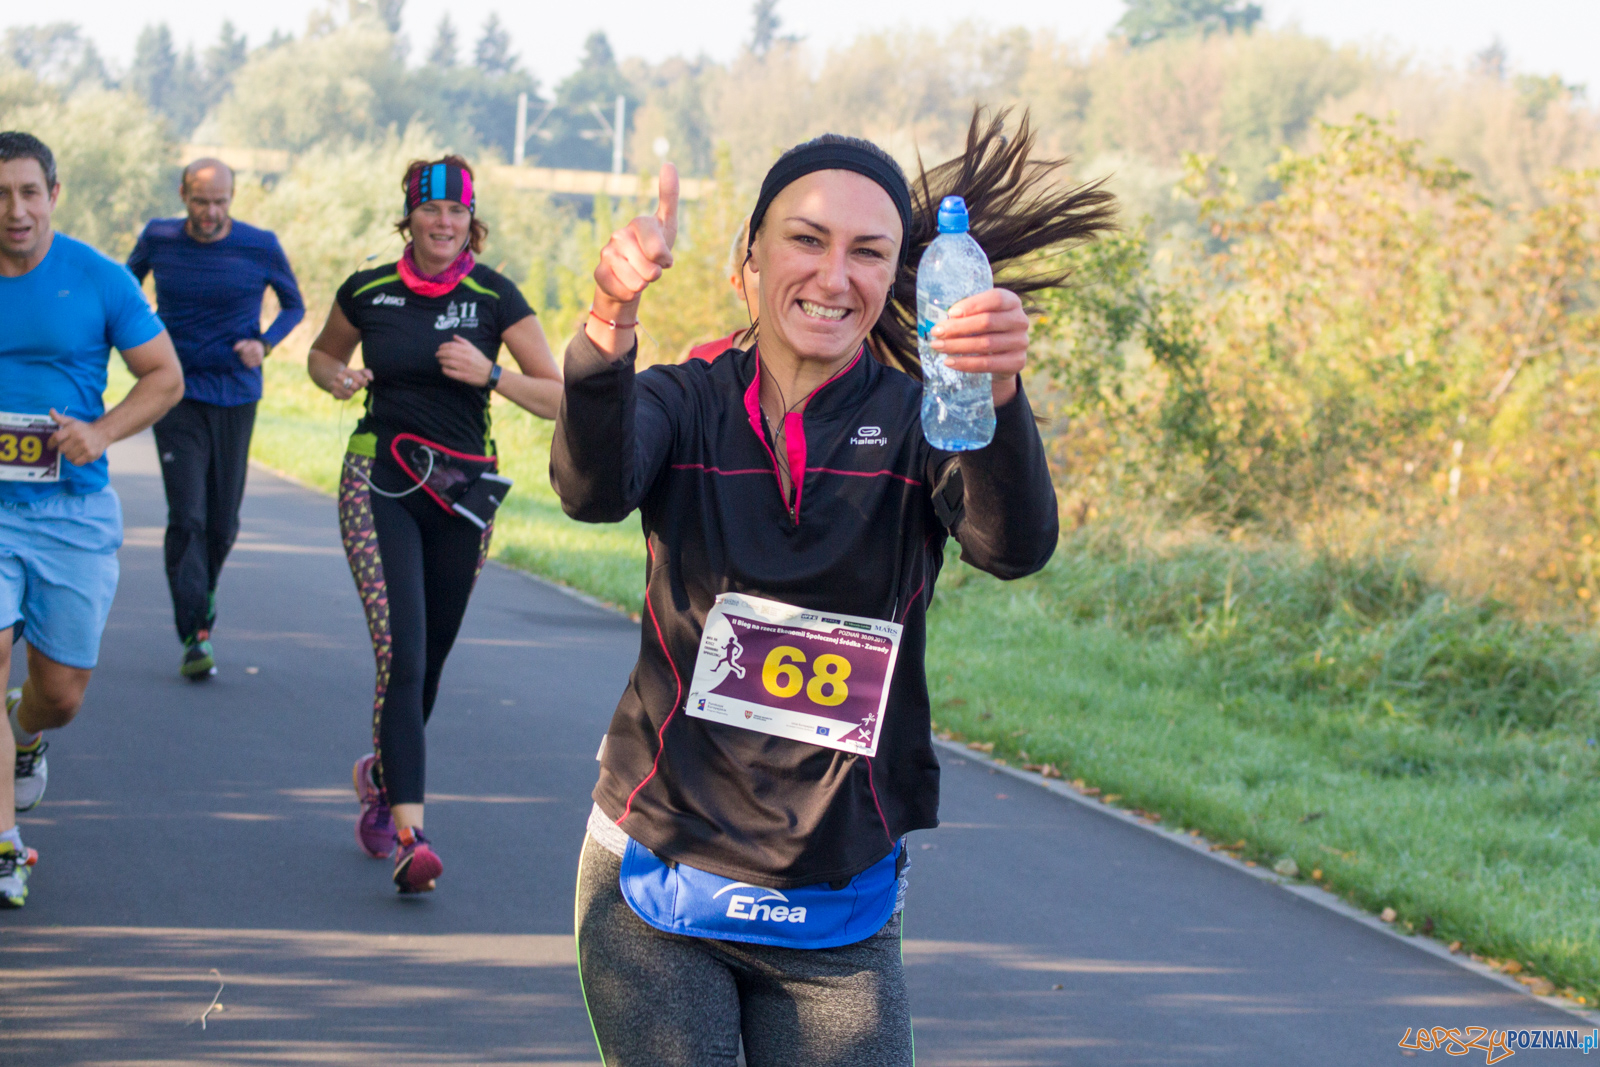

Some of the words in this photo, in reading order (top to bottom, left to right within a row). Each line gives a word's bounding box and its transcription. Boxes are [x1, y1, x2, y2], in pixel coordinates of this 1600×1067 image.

[460, 302, 477, 318] 11
[0, 434, 42, 463] 39
[850, 437, 887, 446] Kalenji
[738, 620, 751, 629] Bieg
[777, 628, 805, 637] Ekonomii
[865, 643, 889, 654] Zawady
[861, 634, 886, 643] 30.09.2017
[874, 625, 898, 635] MARS
[762, 645, 852, 706] 68
[726, 895, 807, 923] Enea
